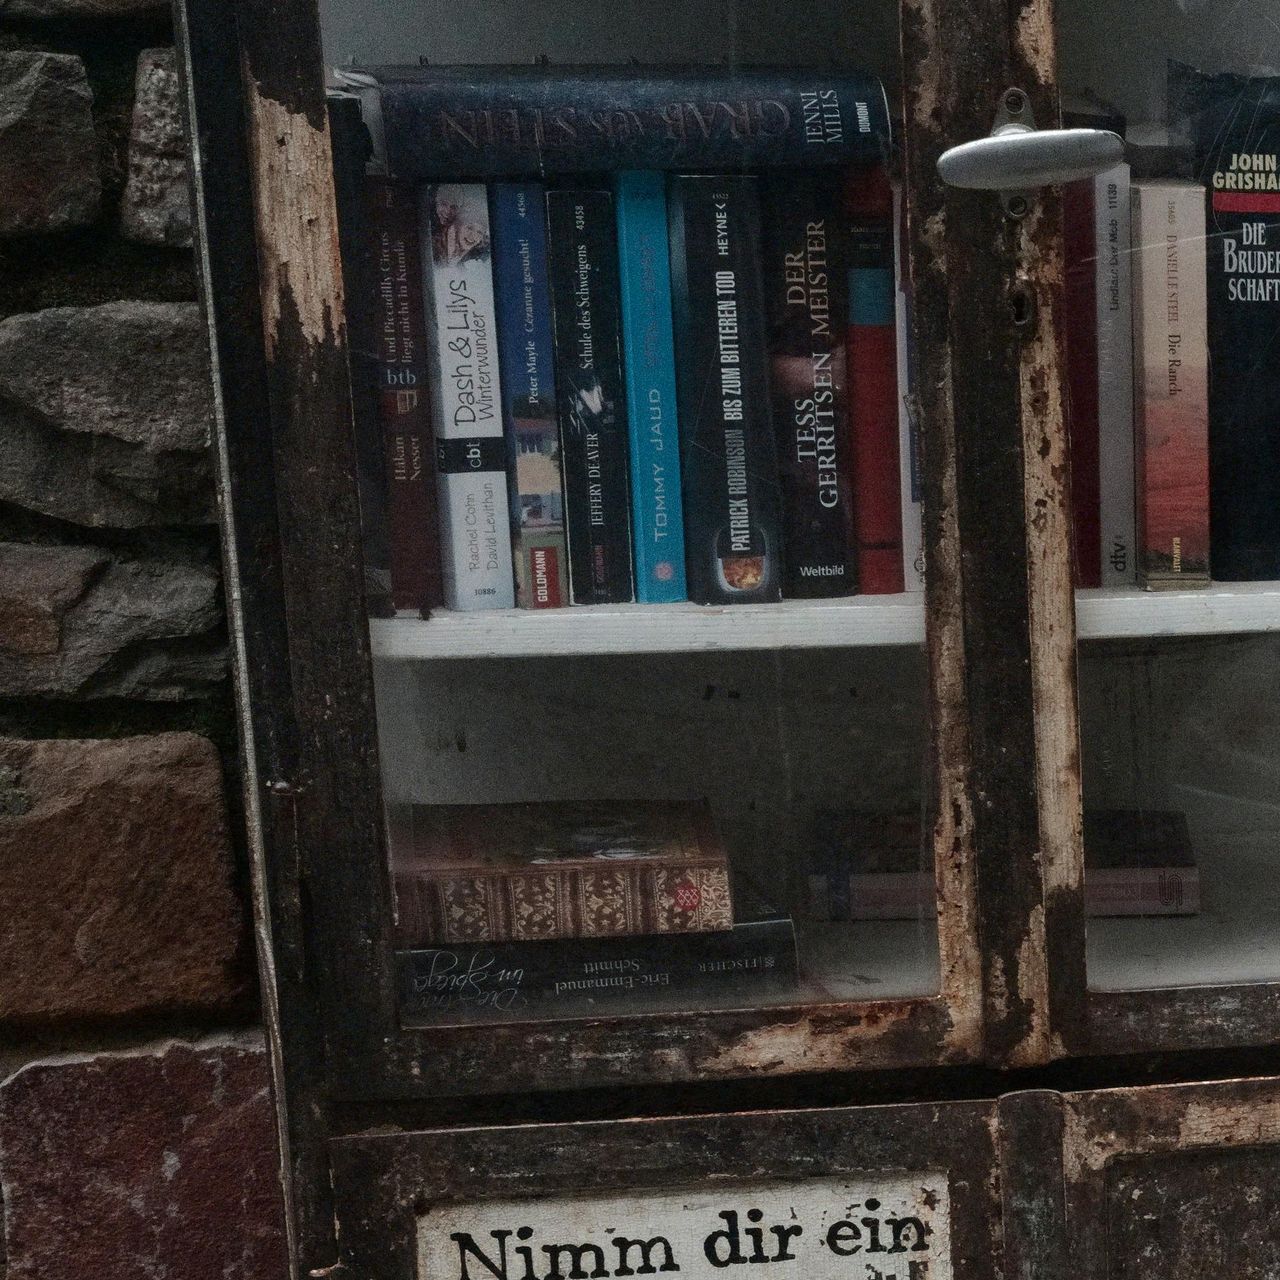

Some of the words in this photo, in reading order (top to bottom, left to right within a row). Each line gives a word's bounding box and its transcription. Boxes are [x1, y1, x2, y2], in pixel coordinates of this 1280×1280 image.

[800, 91, 821, 146] JENNI
[822, 89, 844, 144] MILLS
[859, 101, 870, 133] DUMONT
[1229, 153, 1277, 172] JOHN
[575, 204, 586, 231] 43458
[717, 211, 729, 256] HEYNE
[1241, 221, 1267, 246] DIE
[519, 238, 536, 284] gesucht!
[576, 244, 593, 308] Schweigens
[786, 251, 807, 306] DER
[806, 218, 830, 336] MEISTER
[1167, 234, 1178, 289] DANIELLE
[715, 270, 737, 297] TOD
[1227, 278, 1280, 302] SCHAFT
[382, 276, 397, 336] Piccadilly
[399, 301, 412, 335] nicht
[445, 279, 476, 330] Lilys
[522, 286, 536, 333] Cézanne
[578, 310, 592, 330] des
[1167, 290, 1179, 325] STEEL
[385, 337, 398, 364] Und
[399, 338, 413, 364] liegt
[447, 336, 471, 359] &
[578, 332, 595, 370] Schule
[719, 300, 740, 364] BITTEREN
[1167, 333, 1182, 357] Die
[470, 310, 495, 421] Winterwunder
[526, 340, 540, 374] Mayle
[387, 370, 417, 386] btb
[450, 365, 476, 427] Dash
[528, 376, 541, 405] Peter
[720, 367, 742, 396] ZUM
[1167, 358, 1182, 396] Ranch
[648, 388, 664, 451] JAUD
[722, 399, 743, 422] BIS
[813, 351, 839, 508] GERRITSEN
[795, 398, 816, 463] TESS
[467, 440, 482, 469] cbt
[587, 433, 602, 479] DEAVER
[725, 428, 747, 496] ROBINSON
[463, 493, 478, 526] Cohn
[481, 483, 497, 534] Levithan
[590, 482, 605, 527] JEFFERY
[652, 463, 668, 543] TOMMY
[731, 498, 751, 552] PATRICK
[468, 529, 482, 572] Rachel
[486, 537, 499, 571] David
[1109, 542, 1127, 573] dtv
[1174, 536, 1183, 573] BLANVALET
[536, 550, 549, 602] GOLDMANN
[799, 564, 846, 577] Weltbild
[553, 971, 671, 995] Eric-Emmanuel
[582, 956, 642, 976] Schmitt
[696, 956, 758, 974] FISCHER
[704, 1208, 803, 1266] dir
[827, 1199, 931, 1257] ein
